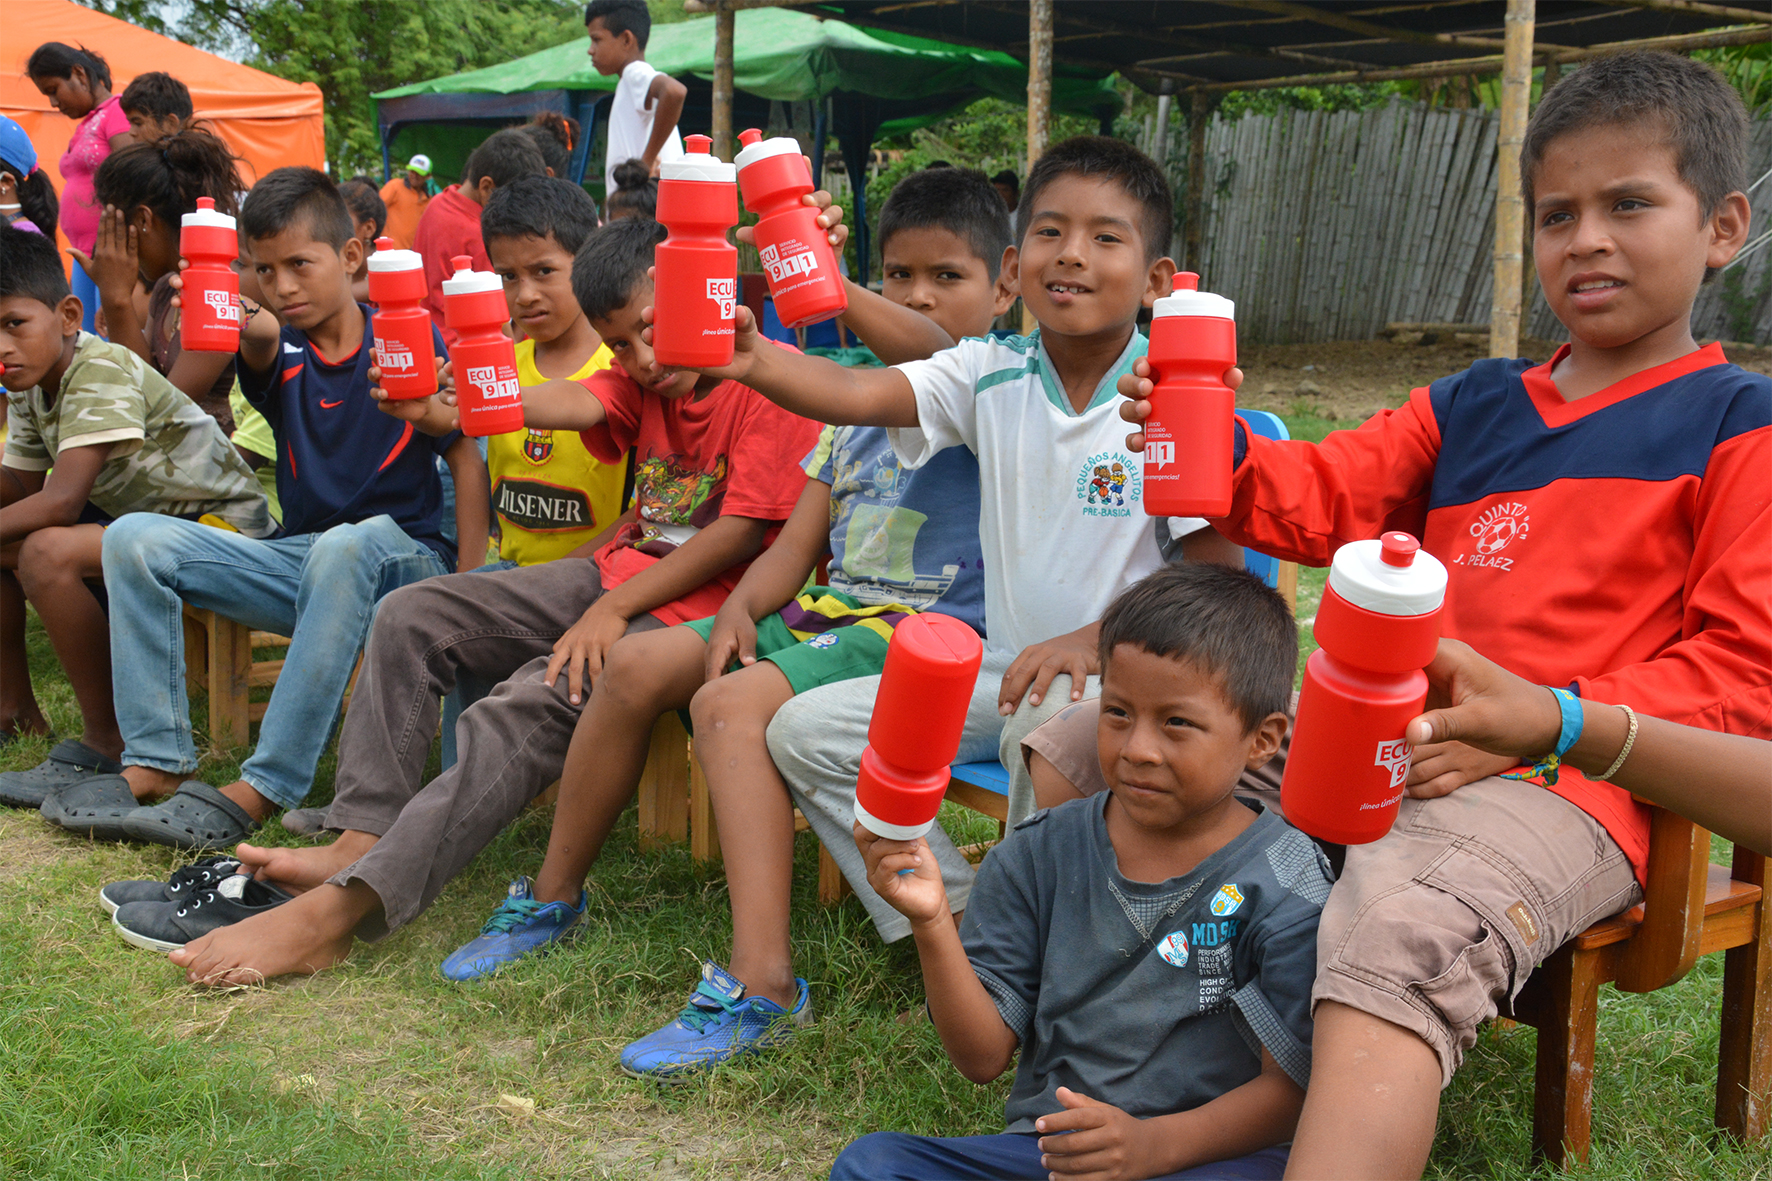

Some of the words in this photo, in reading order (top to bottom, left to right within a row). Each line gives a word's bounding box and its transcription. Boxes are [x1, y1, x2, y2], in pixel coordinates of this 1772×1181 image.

[779, 239, 796, 247] SERVICIO
[780, 242, 803, 252] INTEGRADO
[788, 245, 810, 256] SEGURIDAD
[772, 255, 812, 279] 911
[710, 282, 732, 296] ECU
[207, 292, 227, 303] ECU
[379, 354, 409, 366] 911
[469, 369, 493, 382] ECU
[486, 380, 518, 397] 911
[482, 404, 498, 412] única
[519, 470, 552, 479] CERVEZA
[1077, 452, 1109, 499] PEQUEÑOS
[1111, 452, 1142, 502] ANGELITOS
[499, 483, 582, 522] PILSENER
[1082, 507, 1132, 517] PRE-BASICA
[1469, 502, 1528, 537] QUINTO
[1453, 553, 1464, 565] J.
[1467, 554, 1514, 572] PELAEZ
[1380, 740, 1411, 761] ECU
[1213, 900, 1225, 913] 9
[1191, 919, 1241, 947] MDSH
[1198, 962, 1220, 970] TRADE
[1198, 968, 1222, 976] SINCE
[1199, 978, 1218, 986] HIGH
